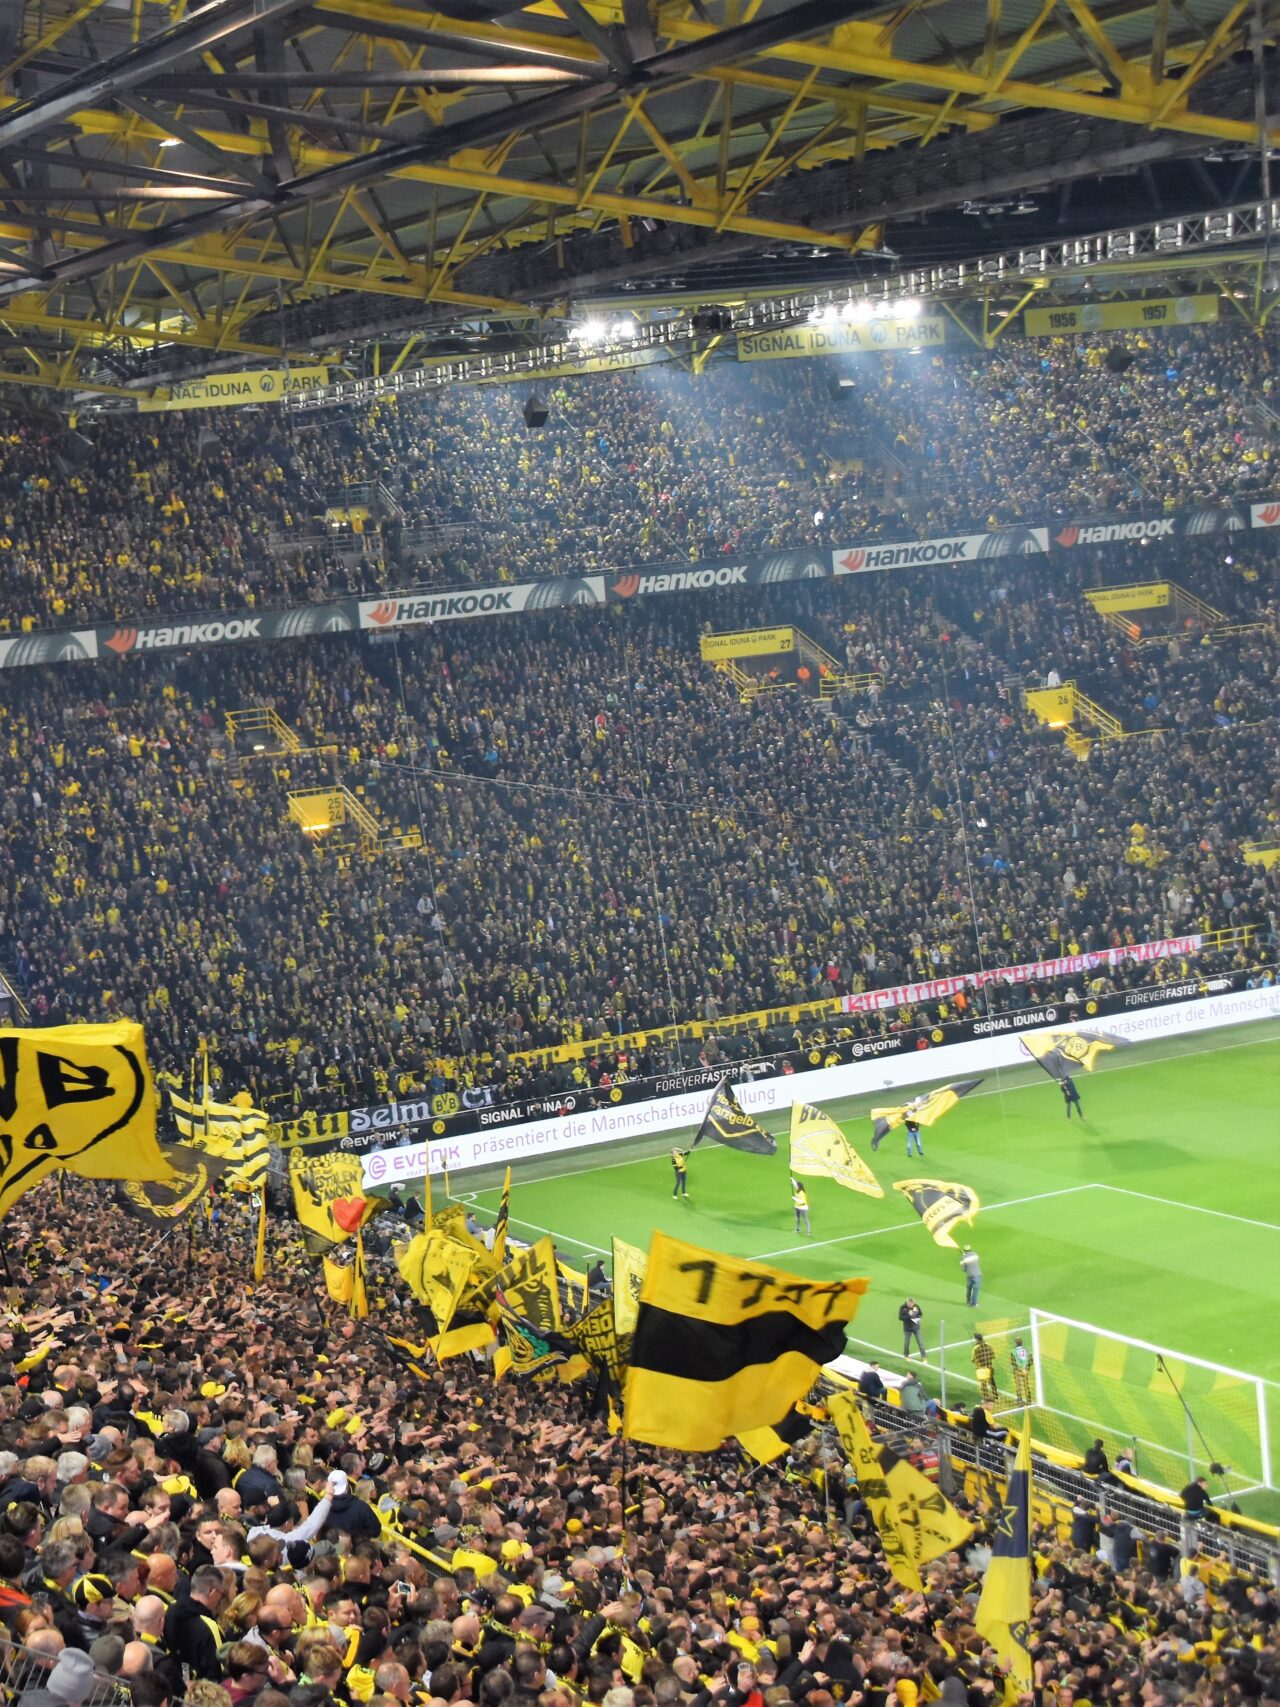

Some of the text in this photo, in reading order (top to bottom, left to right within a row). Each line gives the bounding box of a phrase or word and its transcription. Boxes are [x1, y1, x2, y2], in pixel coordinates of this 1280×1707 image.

[1048, 312, 1077, 329] 1956
[1141, 305, 1167, 321] 1957
[742, 323, 941, 354] SIGNAL IDUNA PARK
[171, 375, 322, 401] NAL IDUNA PARK
[1077, 518, 1176, 545] HANKOOK
[864, 540, 967, 568] HANKOOK
[637, 565, 749, 594] HANKOOK
[396, 591, 513, 621] HANKOOK
[1156, 594, 1167, 604] 27
[134, 617, 263, 649] HANKOOK
[758, 633, 777, 642] PARK
[780, 639, 791, 649] 27
[1057, 695, 1069, 705] 26
[327, 797, 341, 810] 25
[328, 810, 342, 822] 24
[1184, 1001, 1205, 1021] die
[973, 1013, 1045, 1034] SIGNAL IDUNA
[351, 1100, 431, 1132] Selm
[480, 1109, 525, 1125] SIGNAL
[472, 1124, 558, 1160] präsentiert
[563, 1119, 587, 1137] die
